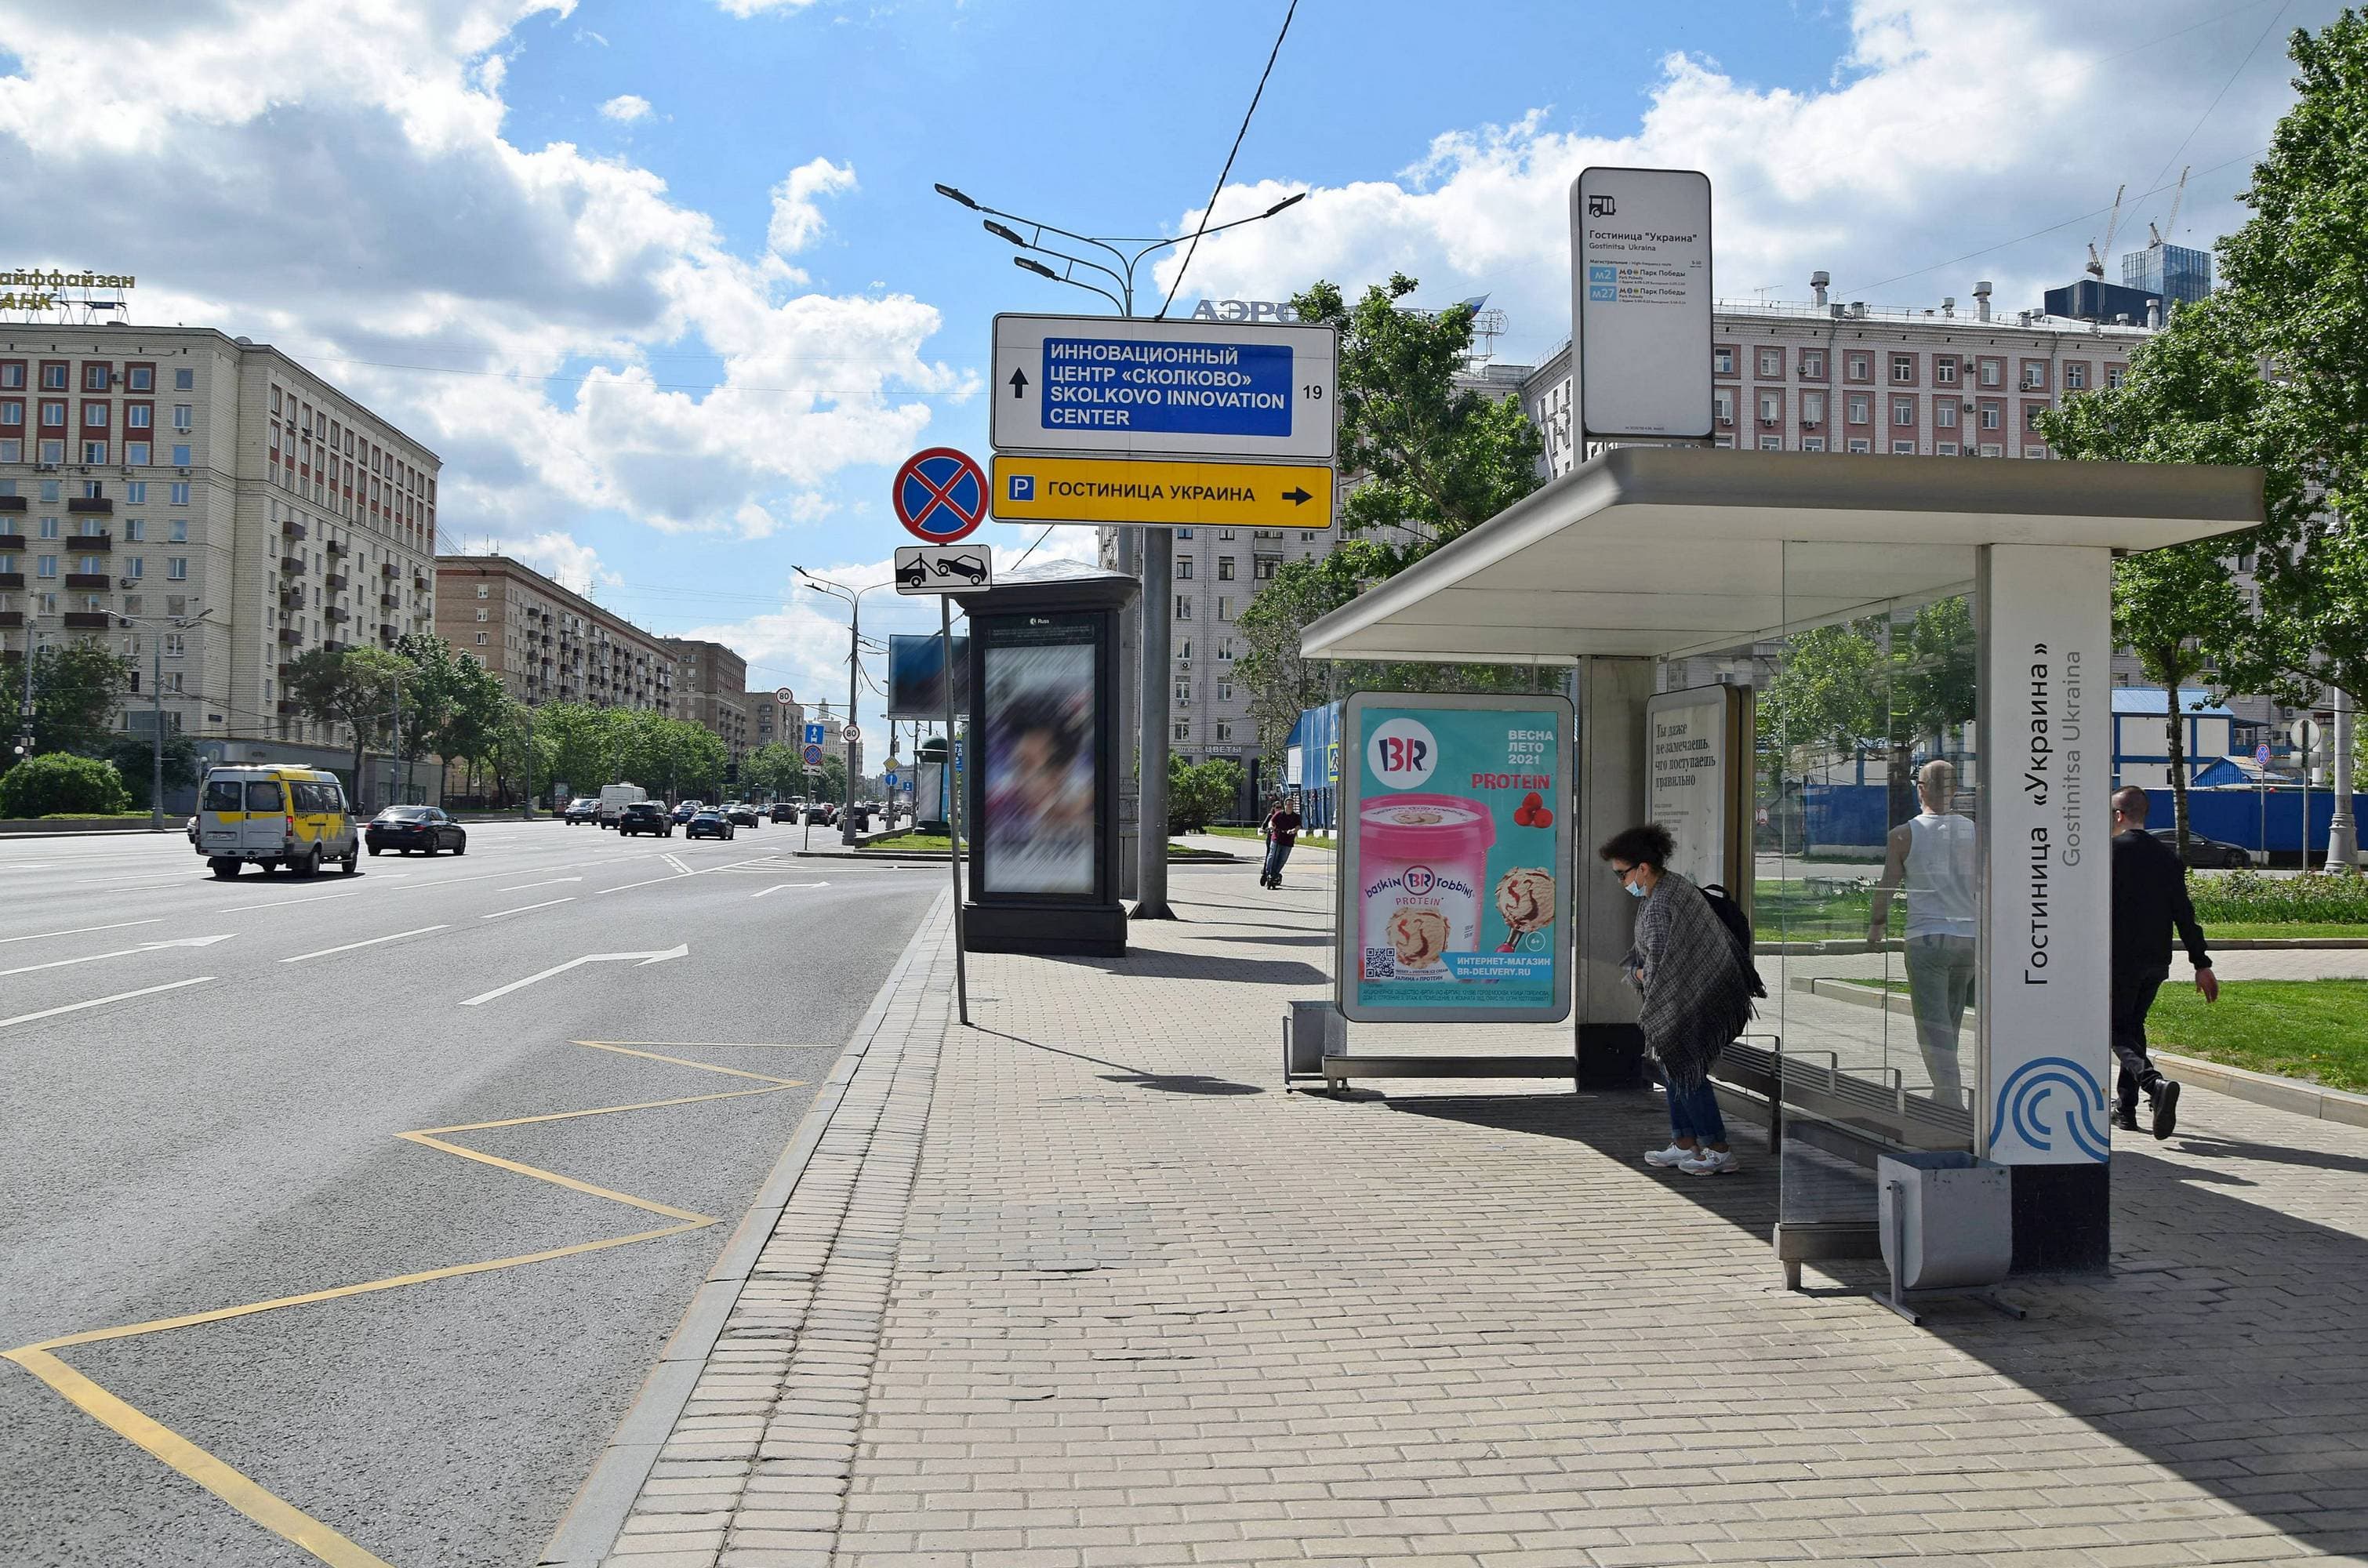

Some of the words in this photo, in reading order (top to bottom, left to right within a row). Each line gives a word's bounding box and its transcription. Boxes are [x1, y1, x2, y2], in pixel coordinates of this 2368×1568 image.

[1589, 230, 1643, 241] Гостиница
[1645, 232, 1698, 243] "Украина"
[1051, 343, 1239, 365] ИННОВАЦИОННЫЙ
[1050, 365, 1117, 383] ЦЕНТР
[1121, 368, 1252, 387] «СКОЛКОВО»
[1050, 387, 1162, 405] SKOLKOVO
[1167, 390, 1285, 410] INNOVATION
[1302, 385, 1323, 400] 19
[1049, 407, 1131, 426] CENTER
[1048, 481, 1164, 501] ГОСТИНИЦА
[1171, 485, 1256, 503] УКРАИНА
[2061, 650, 2081, 741] Ukraina
[1507, 730, 1554, 741] ВЕСНА
[1668, 723, 1687, 737] даже
[1378, 737, 1426, 771] BR
[1507, 742, 1545, 753] ЛЕТО
[1507, 754, 1541, 765] 2021
[1669, 755, 1716, 772] поступаешь
[1471, 773, 1551, 790] PROTEIN
[2061, 749, 2081, 867] Gostinitsa
[1396, 897, 1440, 906] PROTEIN
[2025, 826, 2052, 985] Гостиница
[1457, 957, 1551, 967] ИНТЕРНЕТ-МАГАЗИН
[1457, 967, 1531, 977] BR-DELIVERY.RU
